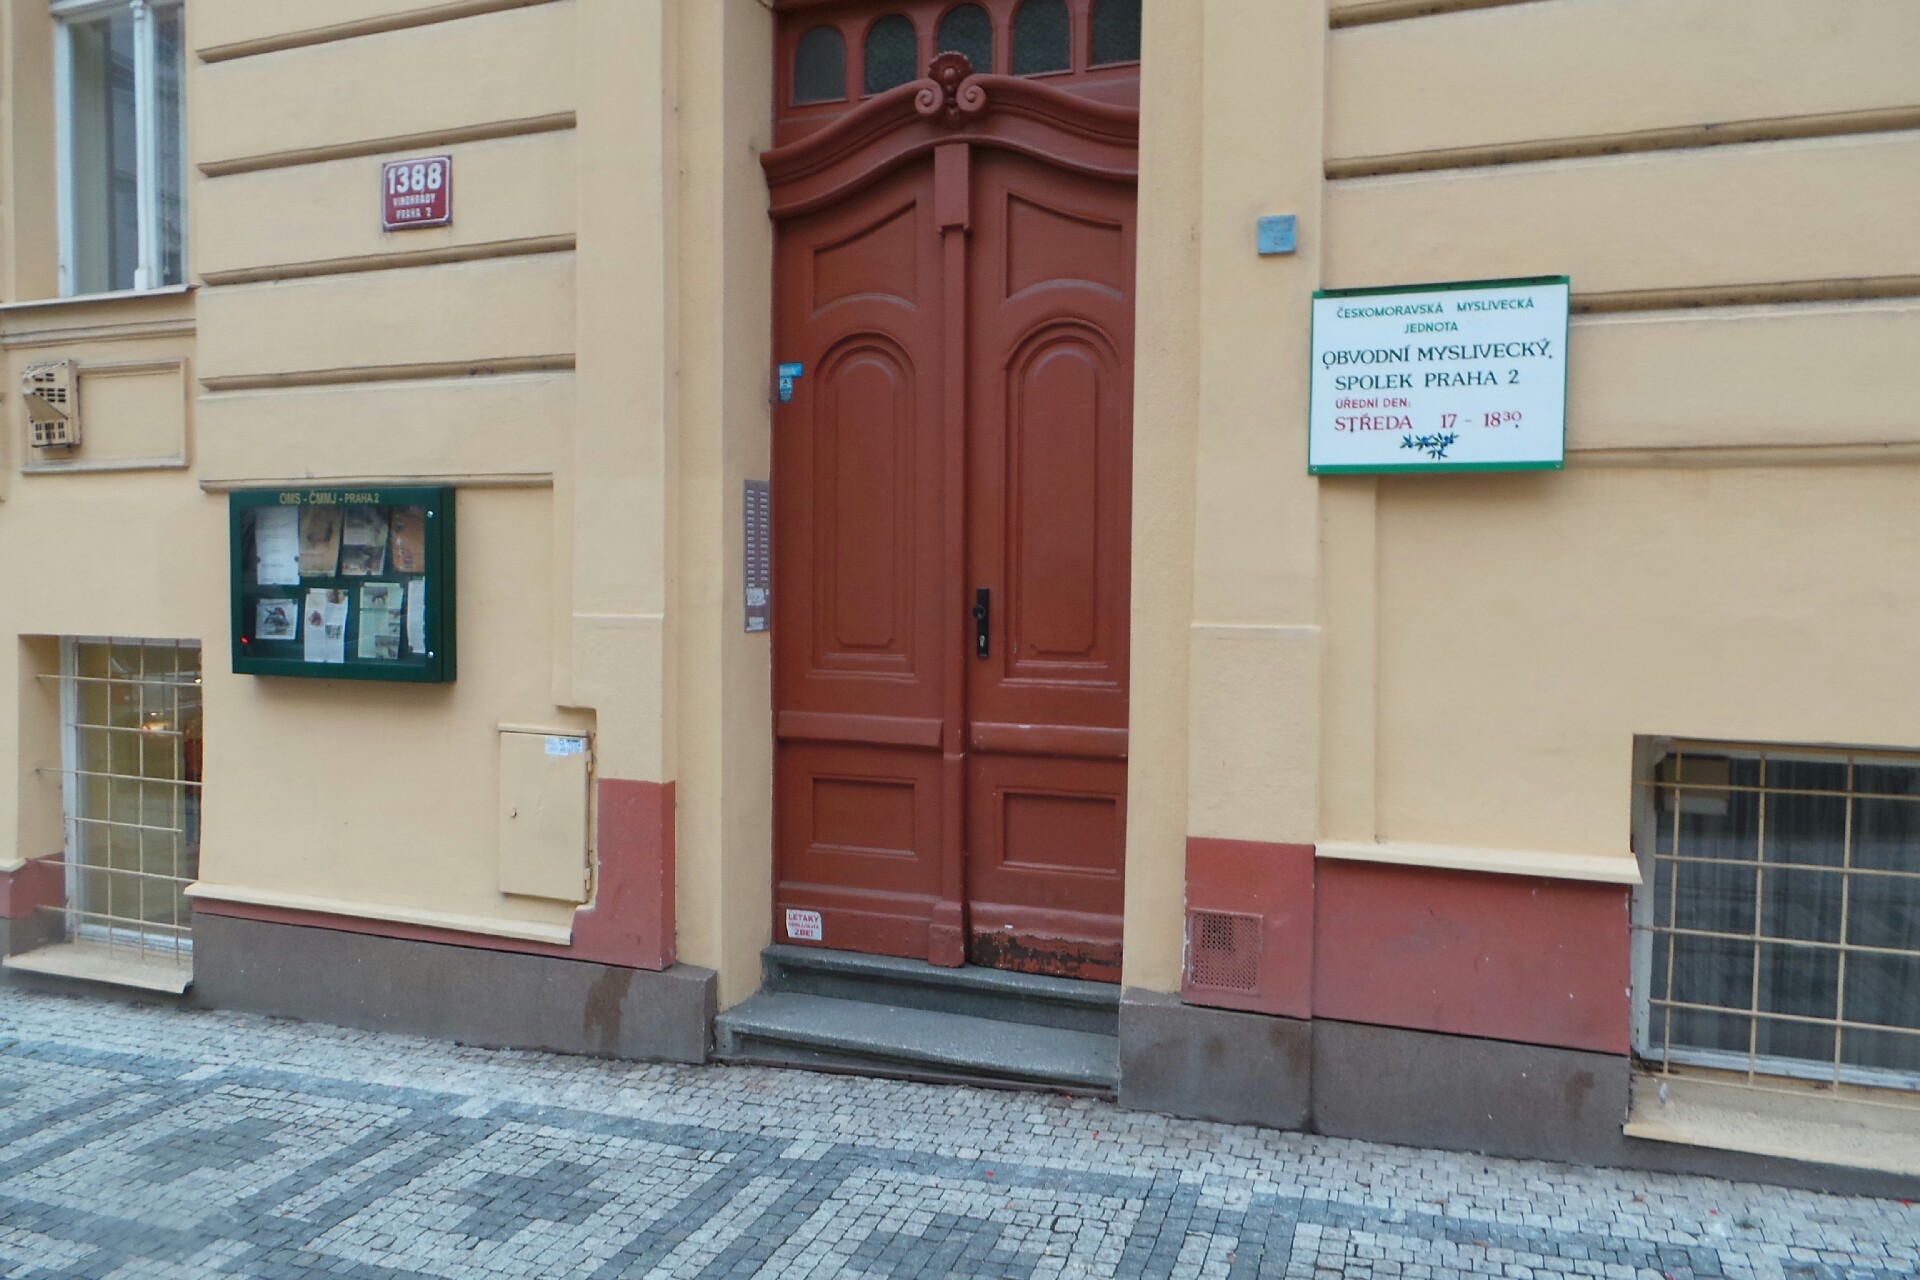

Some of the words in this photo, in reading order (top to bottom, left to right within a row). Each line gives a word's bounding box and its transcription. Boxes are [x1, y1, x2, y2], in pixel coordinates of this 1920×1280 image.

[388, 163, 442, 194] 1388
[396, 208, 421, 219] PRAHA
[425, 207, 432, 218] 2
[1336, 303, 1444, 319] ČESKOMORAVSKÁ
[1456, 297, 1534, 312] MYSLIVECKÁ
[1404, 322, 1459, 334] JEDNOTA
[1322, 345, 1410, 366] OBVODNÍ
[1417, 338, 1551, 363] MYSLIVECKÝ
[1335, 374, 1413, 391] SPOLEK
[1424, 371, 1498, 388] PRAHA
[1507, 369, 1520, 385] 2
[1334, 412, 1414, 432] STŘEDA
[1440, 413, 1458, 429] 17
[344, 492, 373, 504] PRAHA
[374, 492, 380, 504] 2
